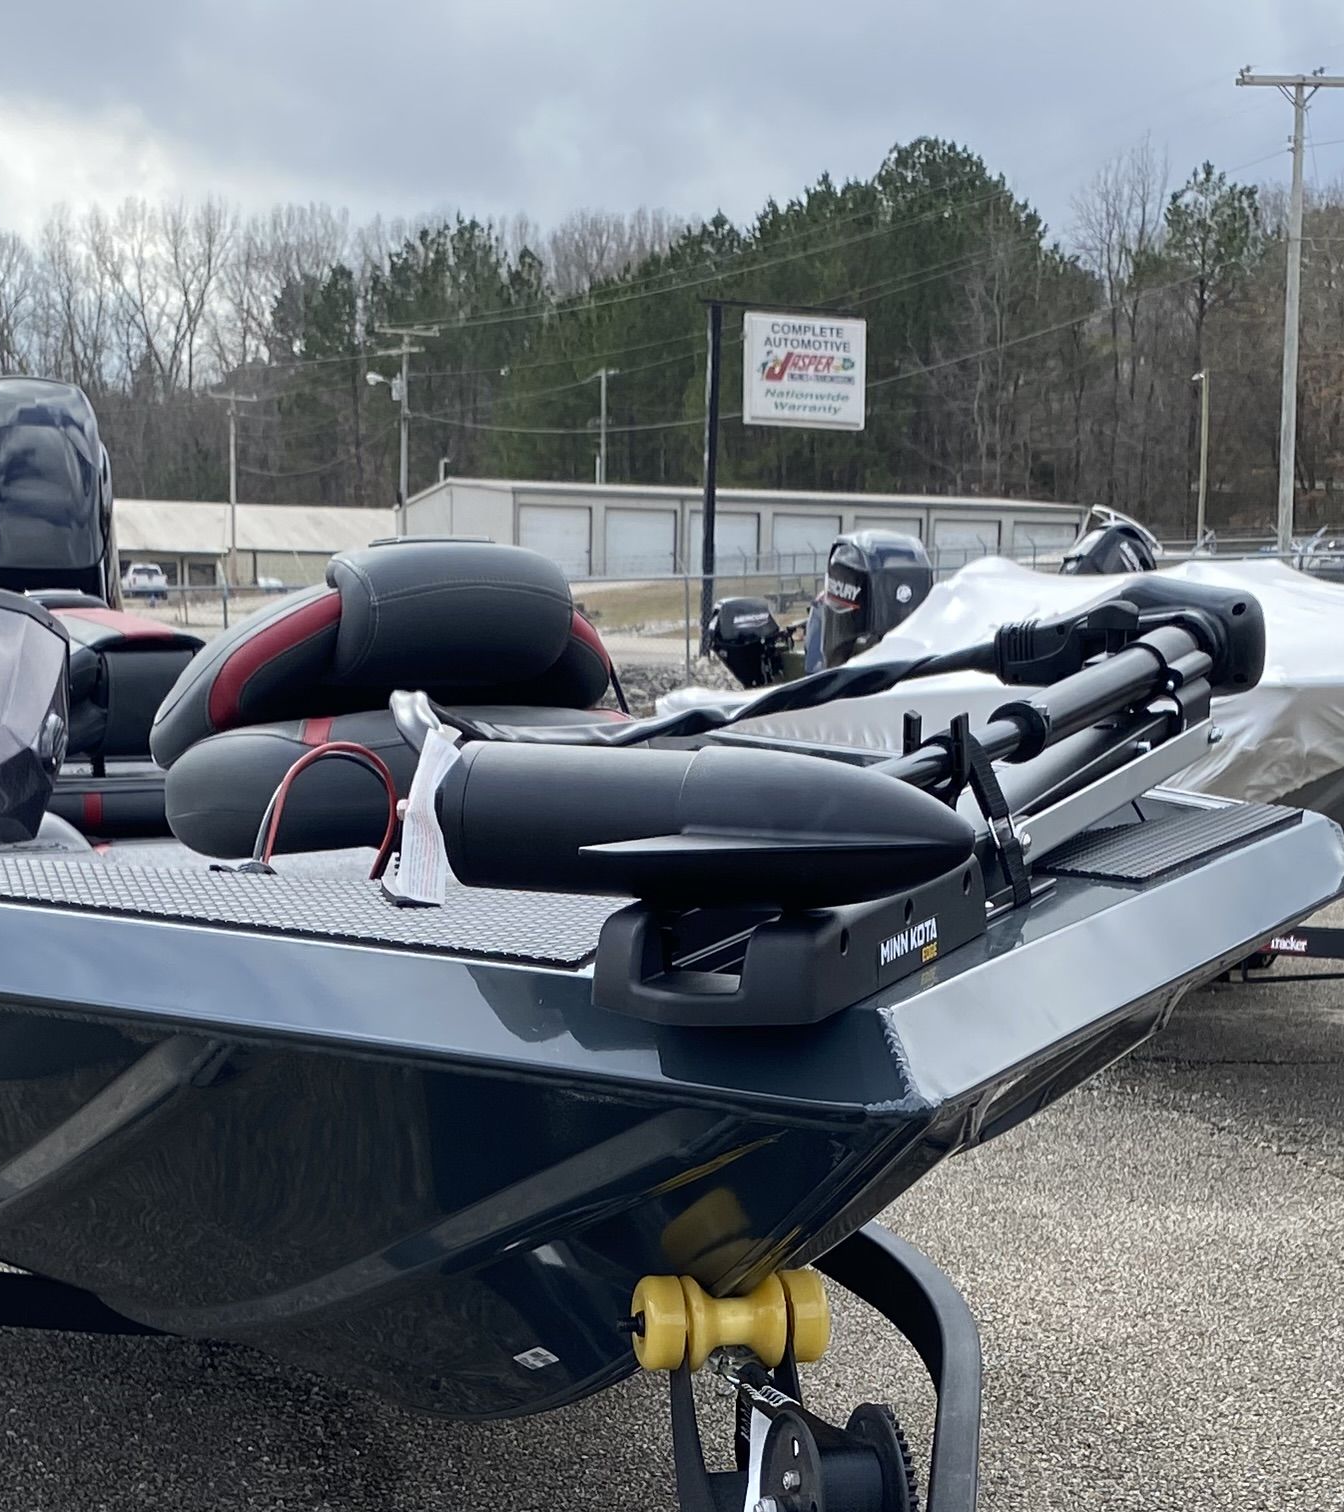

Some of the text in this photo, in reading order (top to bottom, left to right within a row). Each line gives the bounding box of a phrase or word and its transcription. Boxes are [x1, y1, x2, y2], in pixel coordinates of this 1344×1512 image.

[771, 323, 844, 338] COMPLETE
[764, 337, 851, 353] AUTOMOTIVE
[765, 352, 834, 380] JASPER
[764, 388, 849, 402] Nationwide
[773, 401, 842, 416] Warranty
[880, 917, 938, 967] MINN KOTA
